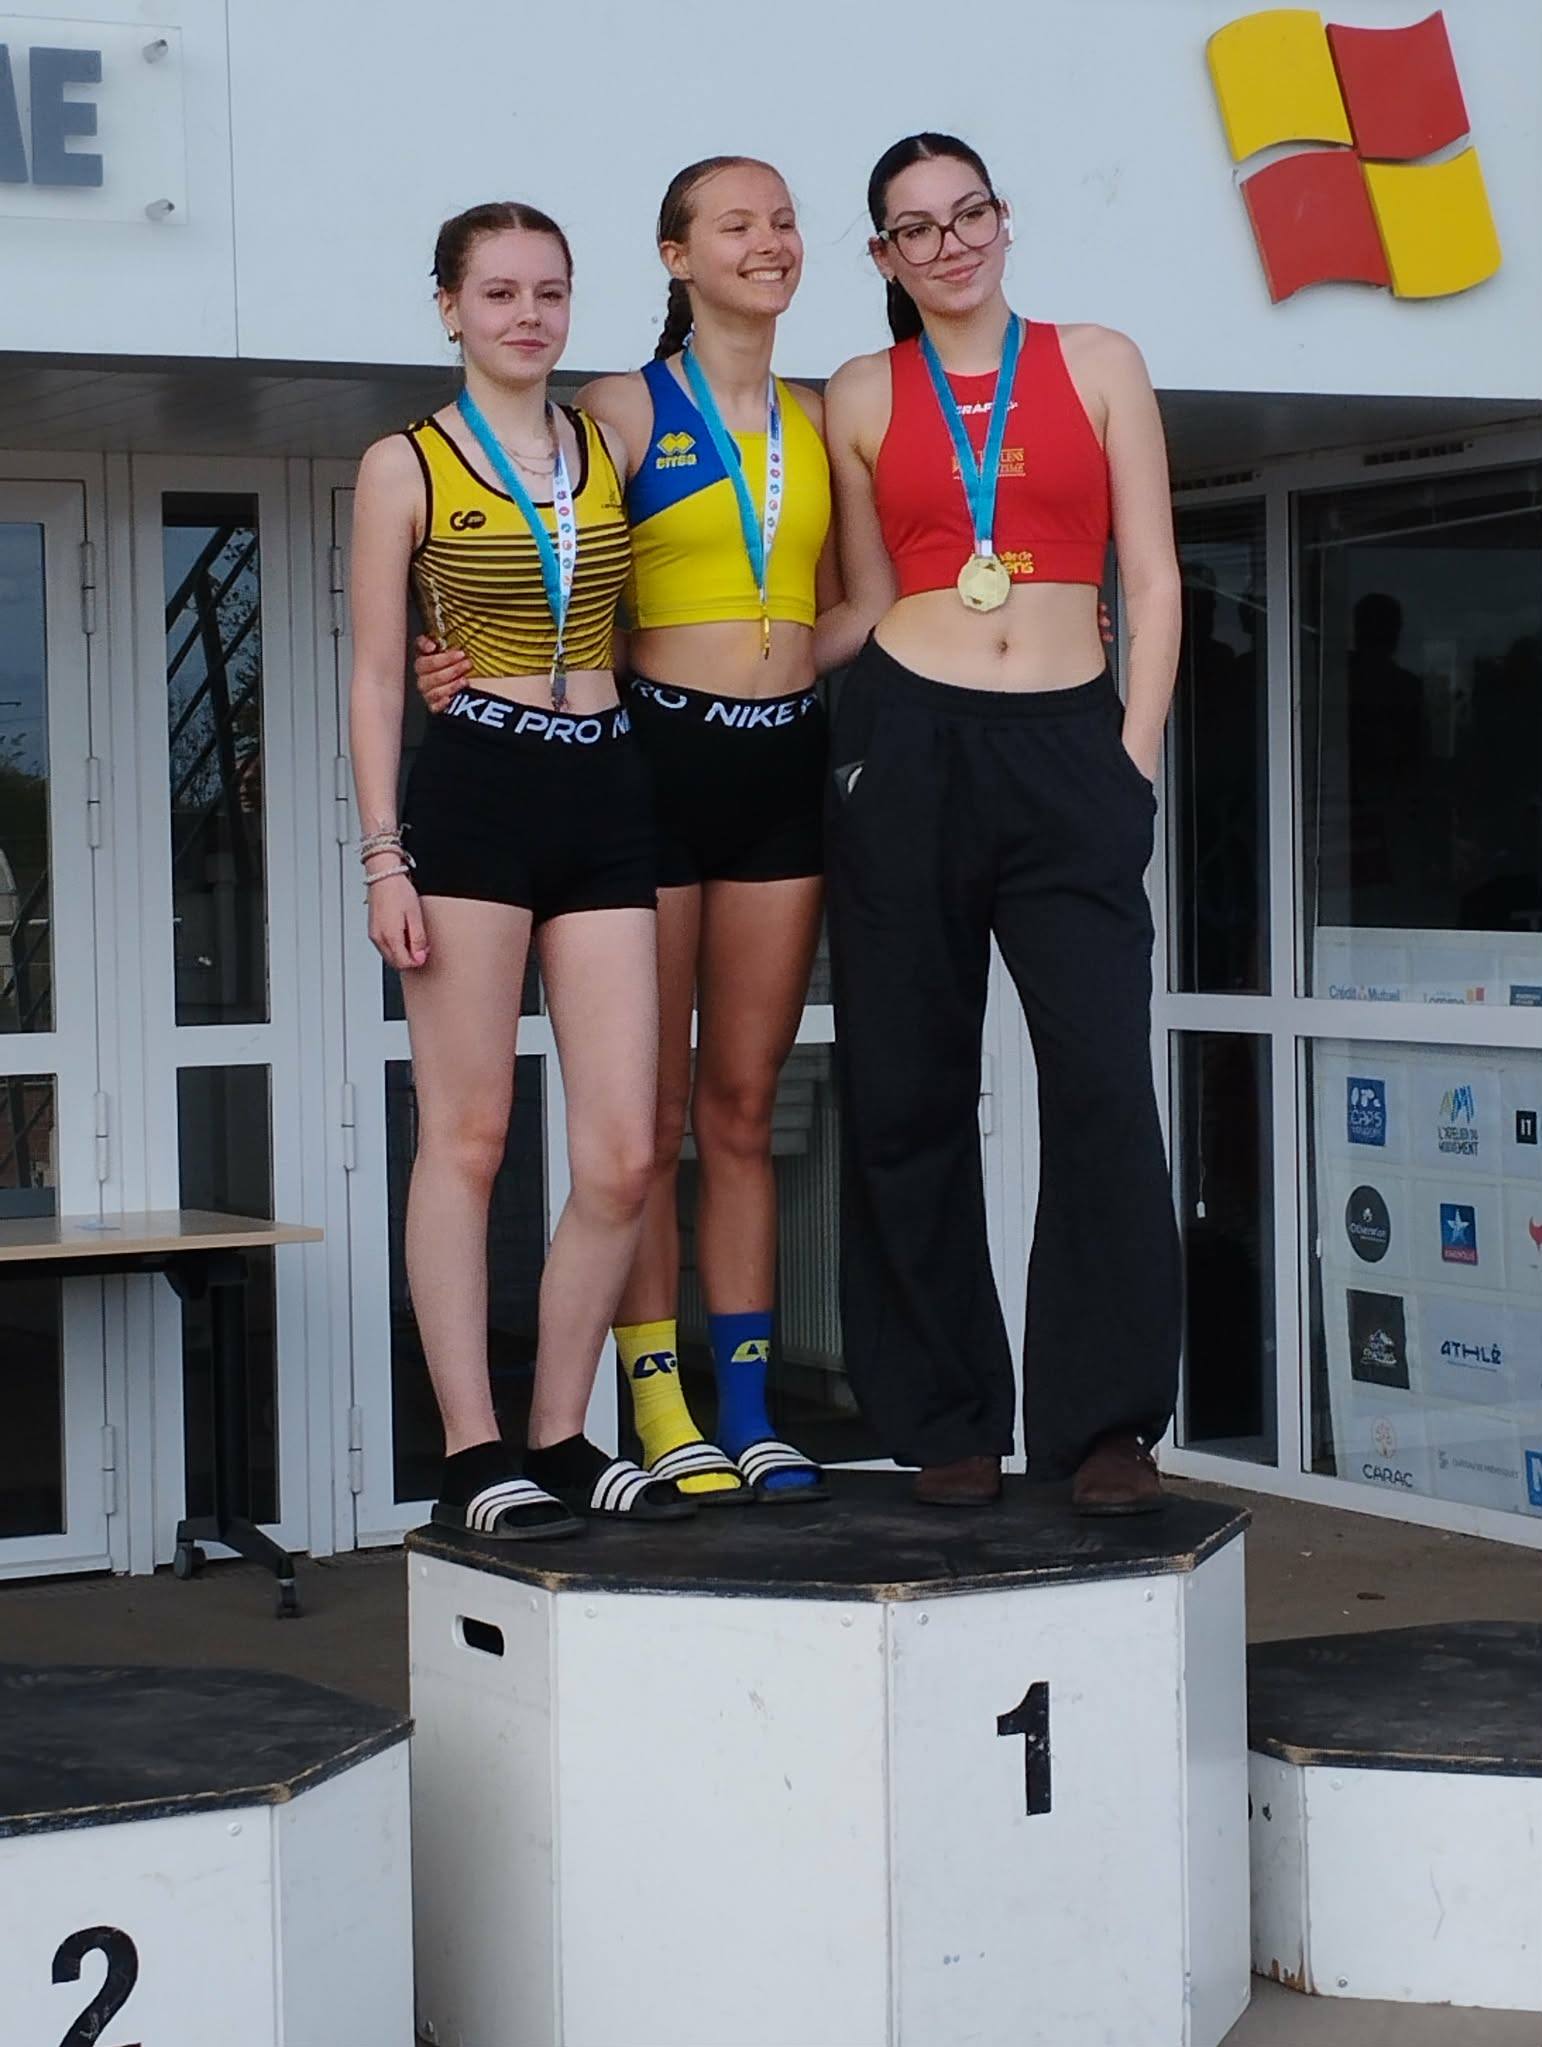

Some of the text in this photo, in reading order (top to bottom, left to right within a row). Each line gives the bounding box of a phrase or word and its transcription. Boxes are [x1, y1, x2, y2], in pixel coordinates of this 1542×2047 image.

[514, 711, 601, 744] PRO
[704, 701, 795, 729] NIKE
[1362, 1463, 1413, 1488] CARAC
[996, 1681, 1051, 1816] 1
[52, 1925, 141, 2047] 2
